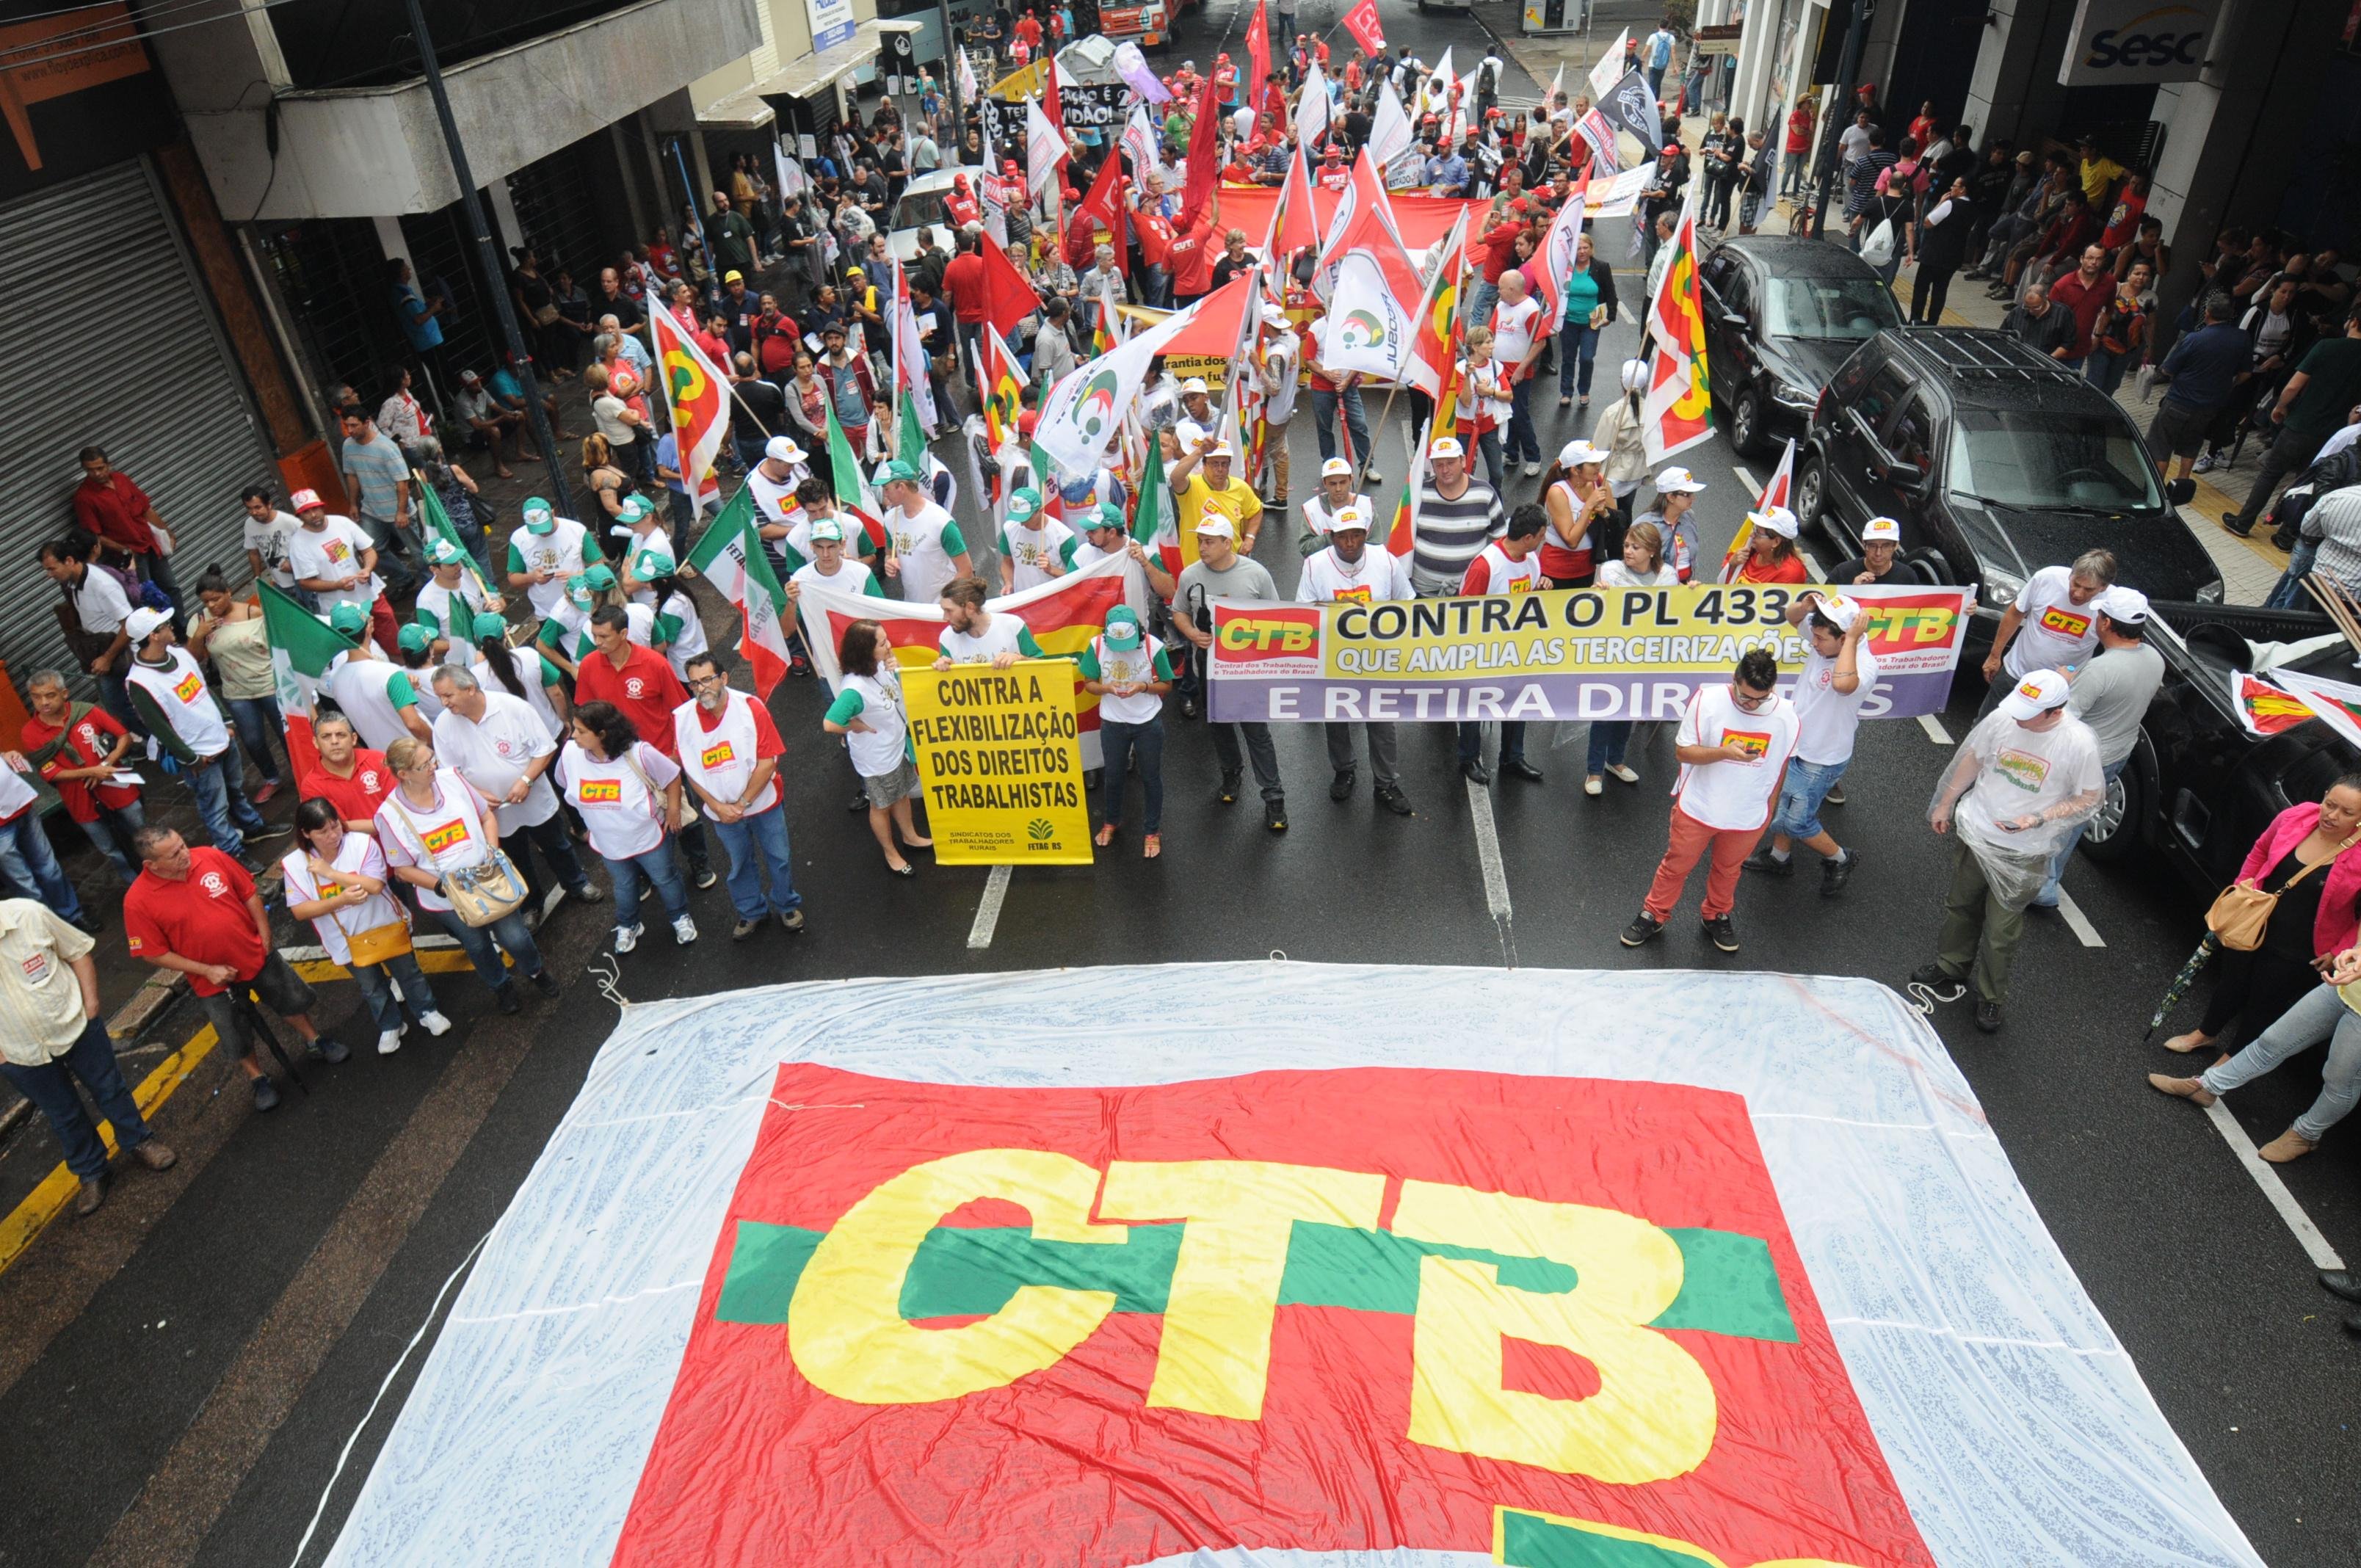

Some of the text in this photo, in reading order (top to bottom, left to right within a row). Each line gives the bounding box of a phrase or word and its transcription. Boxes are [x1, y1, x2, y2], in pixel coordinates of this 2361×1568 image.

[1389, 175, 1411, 189] ESTADO
[1165, 355, 1227, 369] rantia dos
[1336, 595, 1549, 641] CONTRA
[1565, 592, 1604, 628] O
[1622, 590, 1680, 626] PL
[1867, 606, 1954, 643] CTB
[2044, 611, 2087, 635] CTB
[1219, 618, 1313, 652] CTB
[1335, 629, 1813, 675] QUE AMPLIA AS TERCEIRIZAÇÕES
[1890, 654, 1950, 664] Trabalhadores
[1921, 661, 1946, 670] Brasil
[937, 675, 1044, 707] CONTRA A
[1268, 683, 1894, 719] E RETIRA DIRS
[912, 705, 1076, 747] FLEXIBILIZAÇÃO
[703, 746, 731, 766] CTB
[931, 747, 1069, 777] DOS DIREITOS
[581, 783, 619, 799] CTB
[931, 781, 1078, 810] TRABALHISTAS
[425, 824, 465, 849] CTB
[1028, 842, 1062, 851] FETAG RS
[787, 1148, 1719, 1486] CTB
